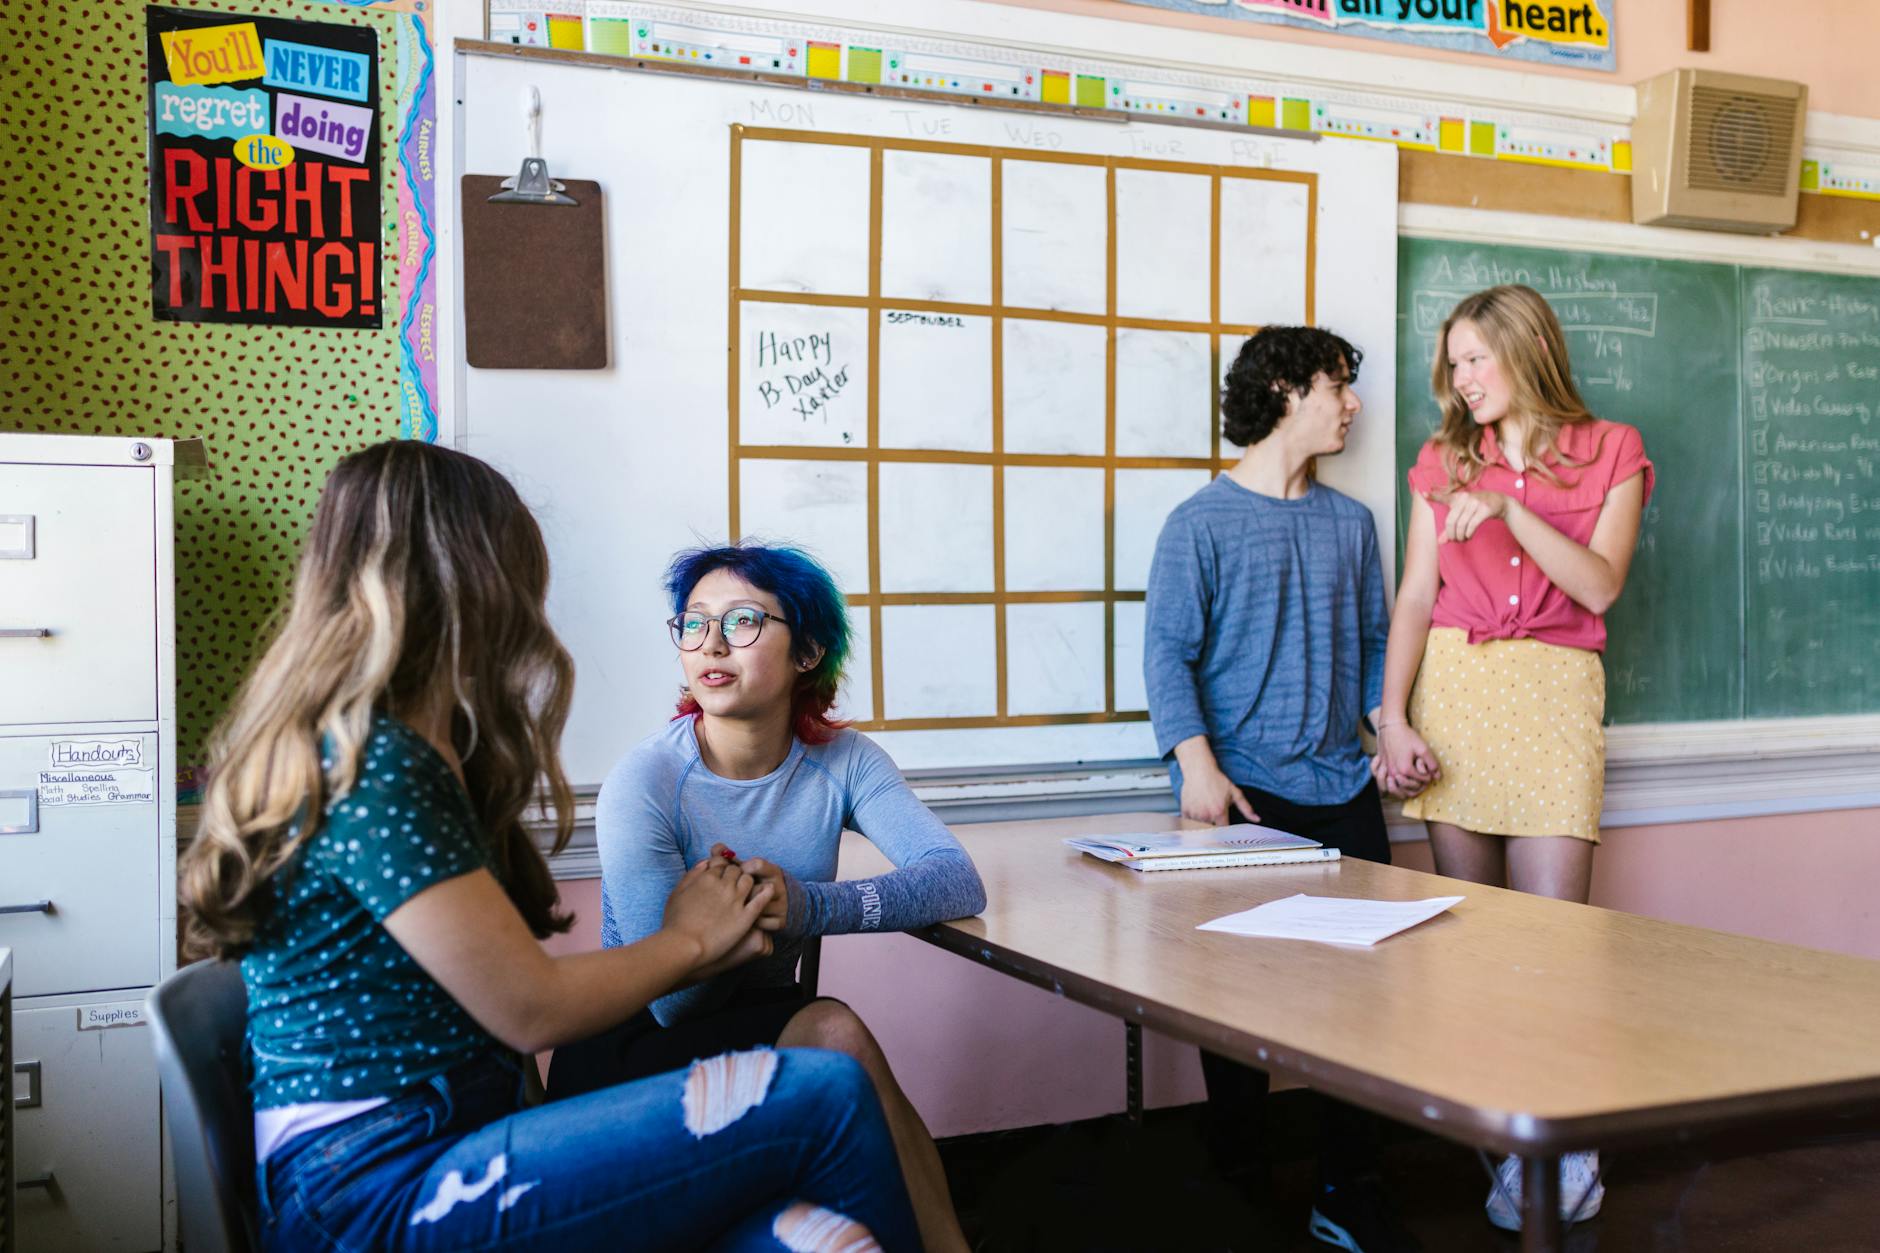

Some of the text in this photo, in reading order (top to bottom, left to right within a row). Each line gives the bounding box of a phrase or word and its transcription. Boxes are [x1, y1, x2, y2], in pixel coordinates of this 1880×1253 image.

[1397, 0, 1477, 21] your
[1504, 0, 1603, 37] heart.
[171, 29, 258, 79] You'll
[270, 46, 362, 94] NEVER
[161, 92, 366, 157] regret doing
[749, 98, 817, 128] MON
[890, 109, 953, 138] TUE
[1003, 121, 1063, 149] WED
[247, 139, 283, 167] the
[420, 118, 433, 182] FAIRNESS
[163, 147, 371, 239] RIGHT
[403, 210, 416, 267] CARING
[155, 233, 376, 319] THING!
[420, 303, 434, 363] RESPECT
[758, 329, 831, 369] Happy
[783, 366, 830, 395] Day
[57, 744, 136, 763] Handouts
[39, 772, 117, 784] Miscellaneous
[40, 783, 121, 795] Math Spelling
[66, 793, 102, 803] Studies
[107, 791, 152, 801] Grammar
[856, 882, 882, 930] PINK
[89, 1008, 139, 1023] Supplies
